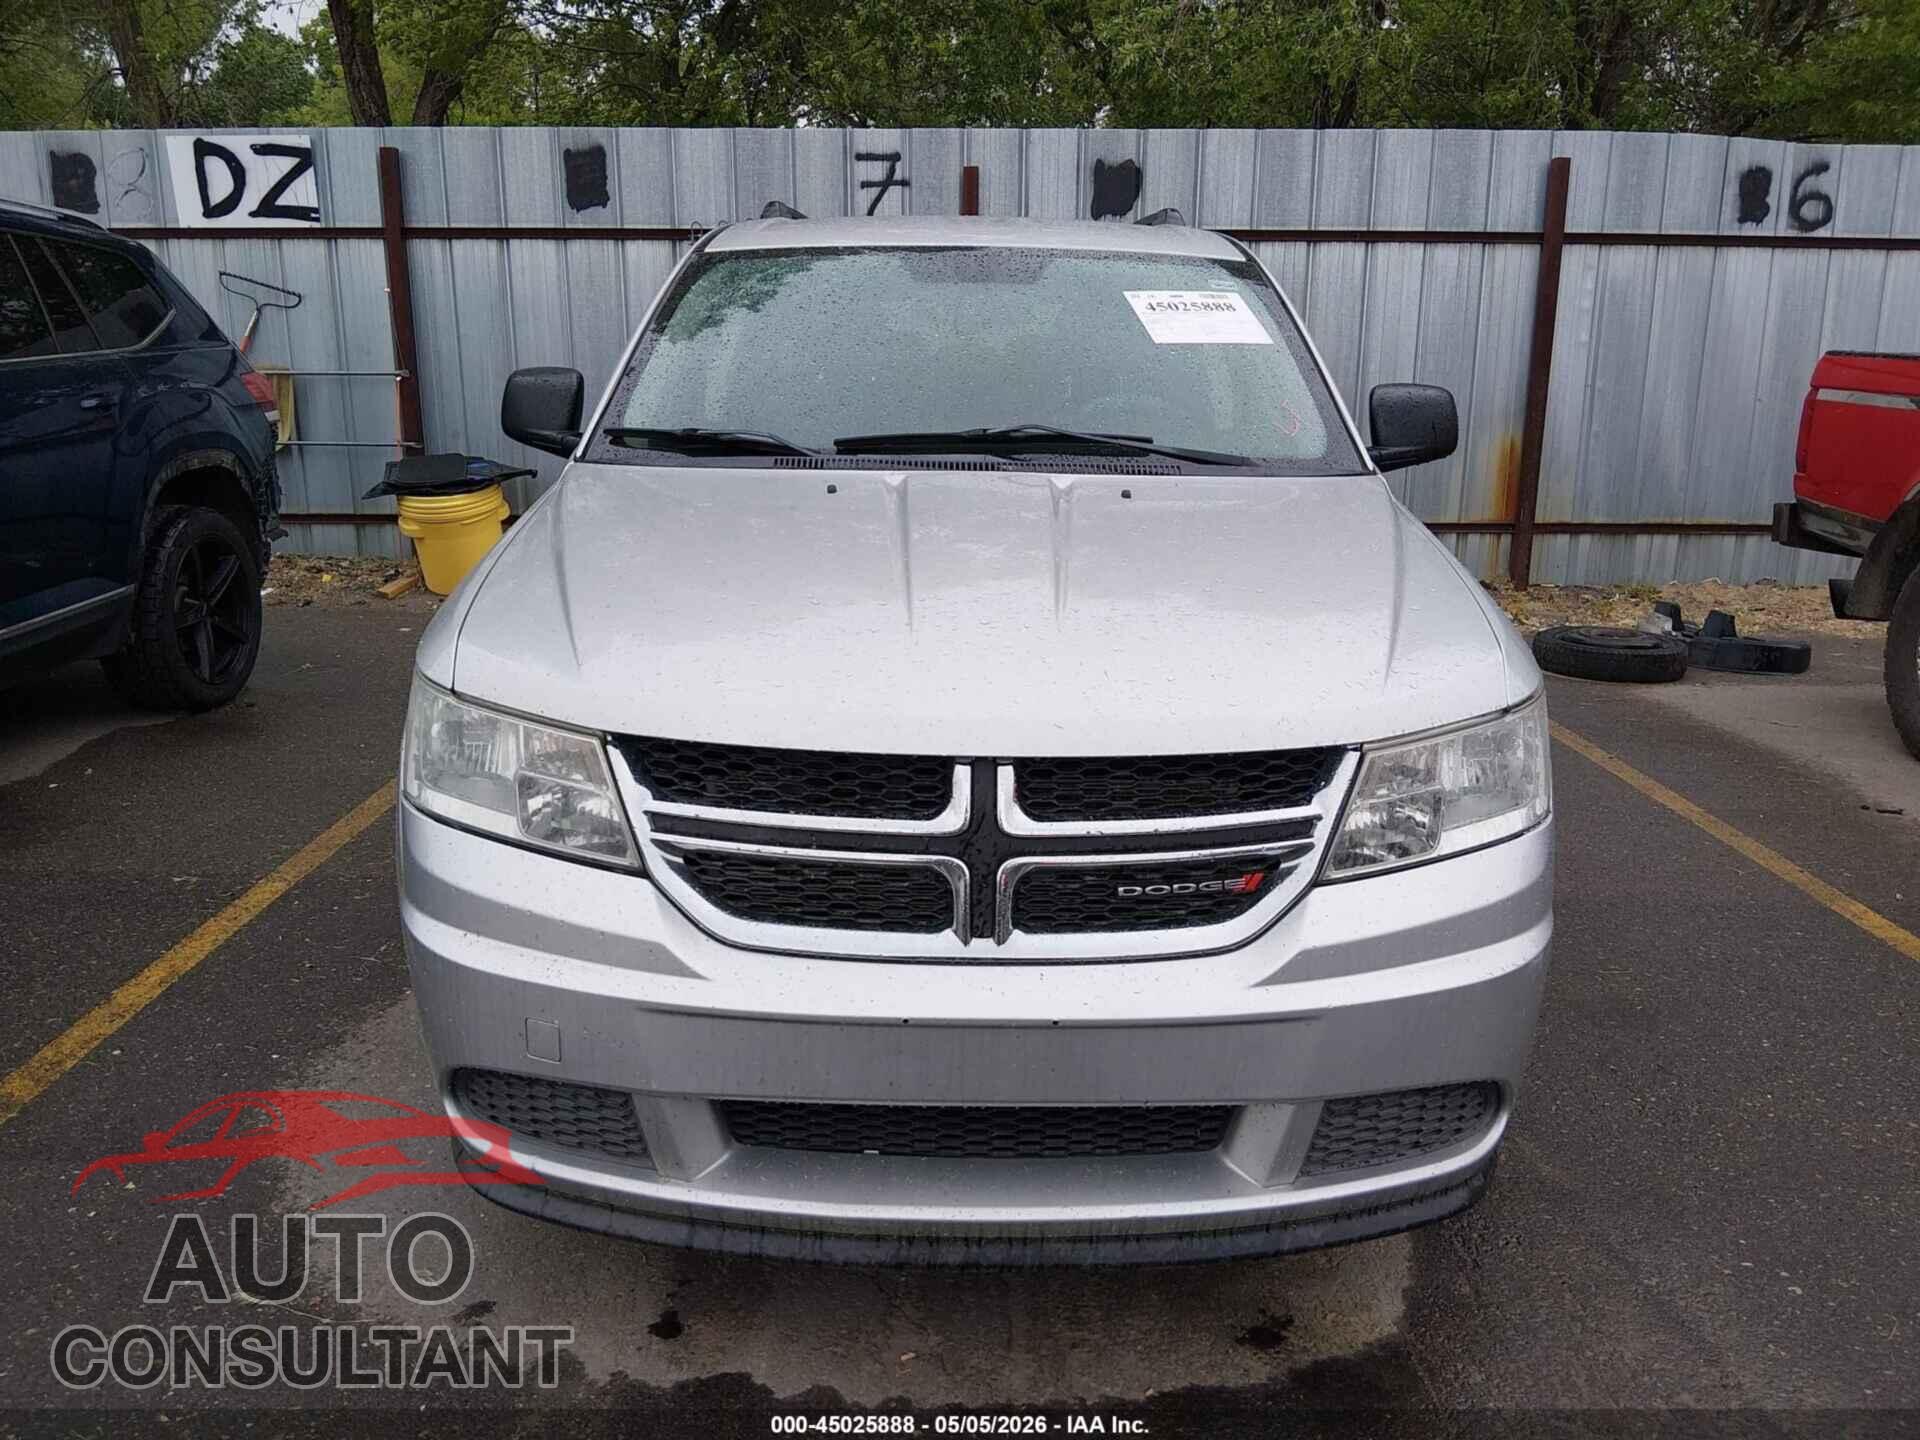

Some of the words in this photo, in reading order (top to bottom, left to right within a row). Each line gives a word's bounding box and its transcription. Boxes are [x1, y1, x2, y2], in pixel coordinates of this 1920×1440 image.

[855, 151, 910, 216] 7
[1145, 301, 1237, 312] 45025888
[1118, 878, 1246, 896] DODGE
